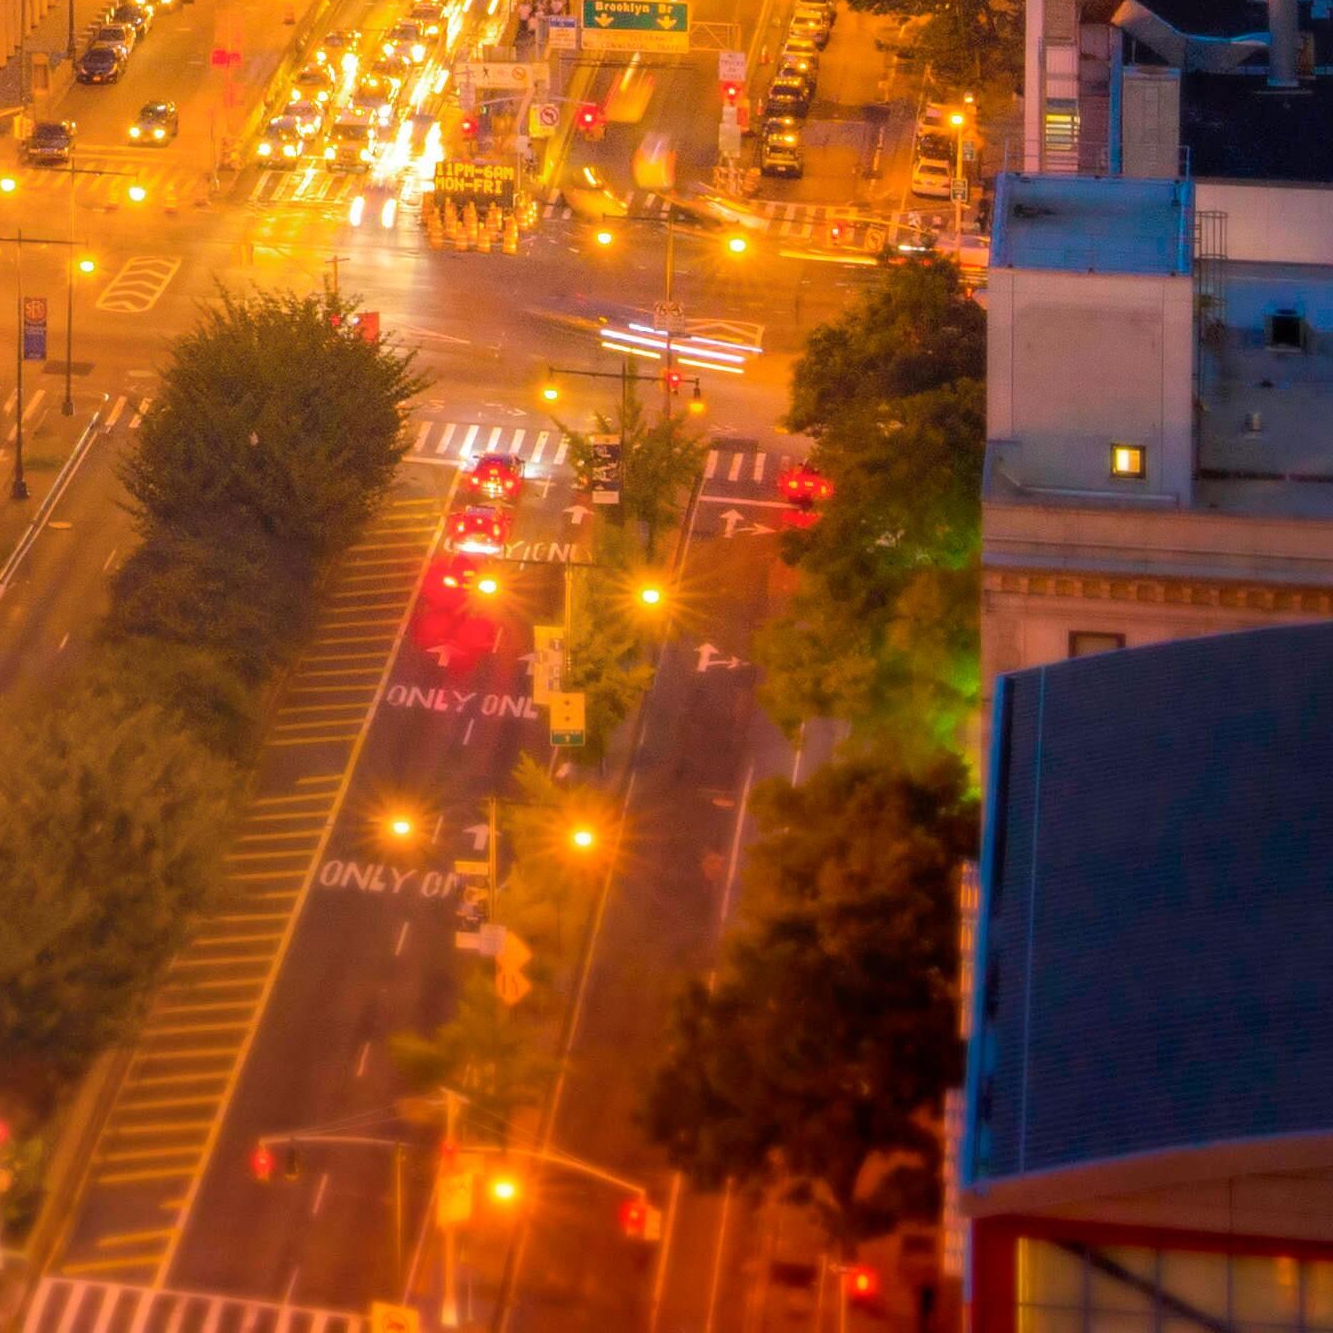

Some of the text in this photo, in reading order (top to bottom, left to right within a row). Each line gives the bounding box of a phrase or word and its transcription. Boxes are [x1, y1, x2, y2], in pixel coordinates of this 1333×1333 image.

[594, 1, 673, 15] Brooklyn Br
[435, 161, 513, 181] 11PM-6AM
[435, 176, 502, 194] MON-FRI
[387, 684, 538, 719] ONLY ONL
[319, 859, 418, 894] ONLY
